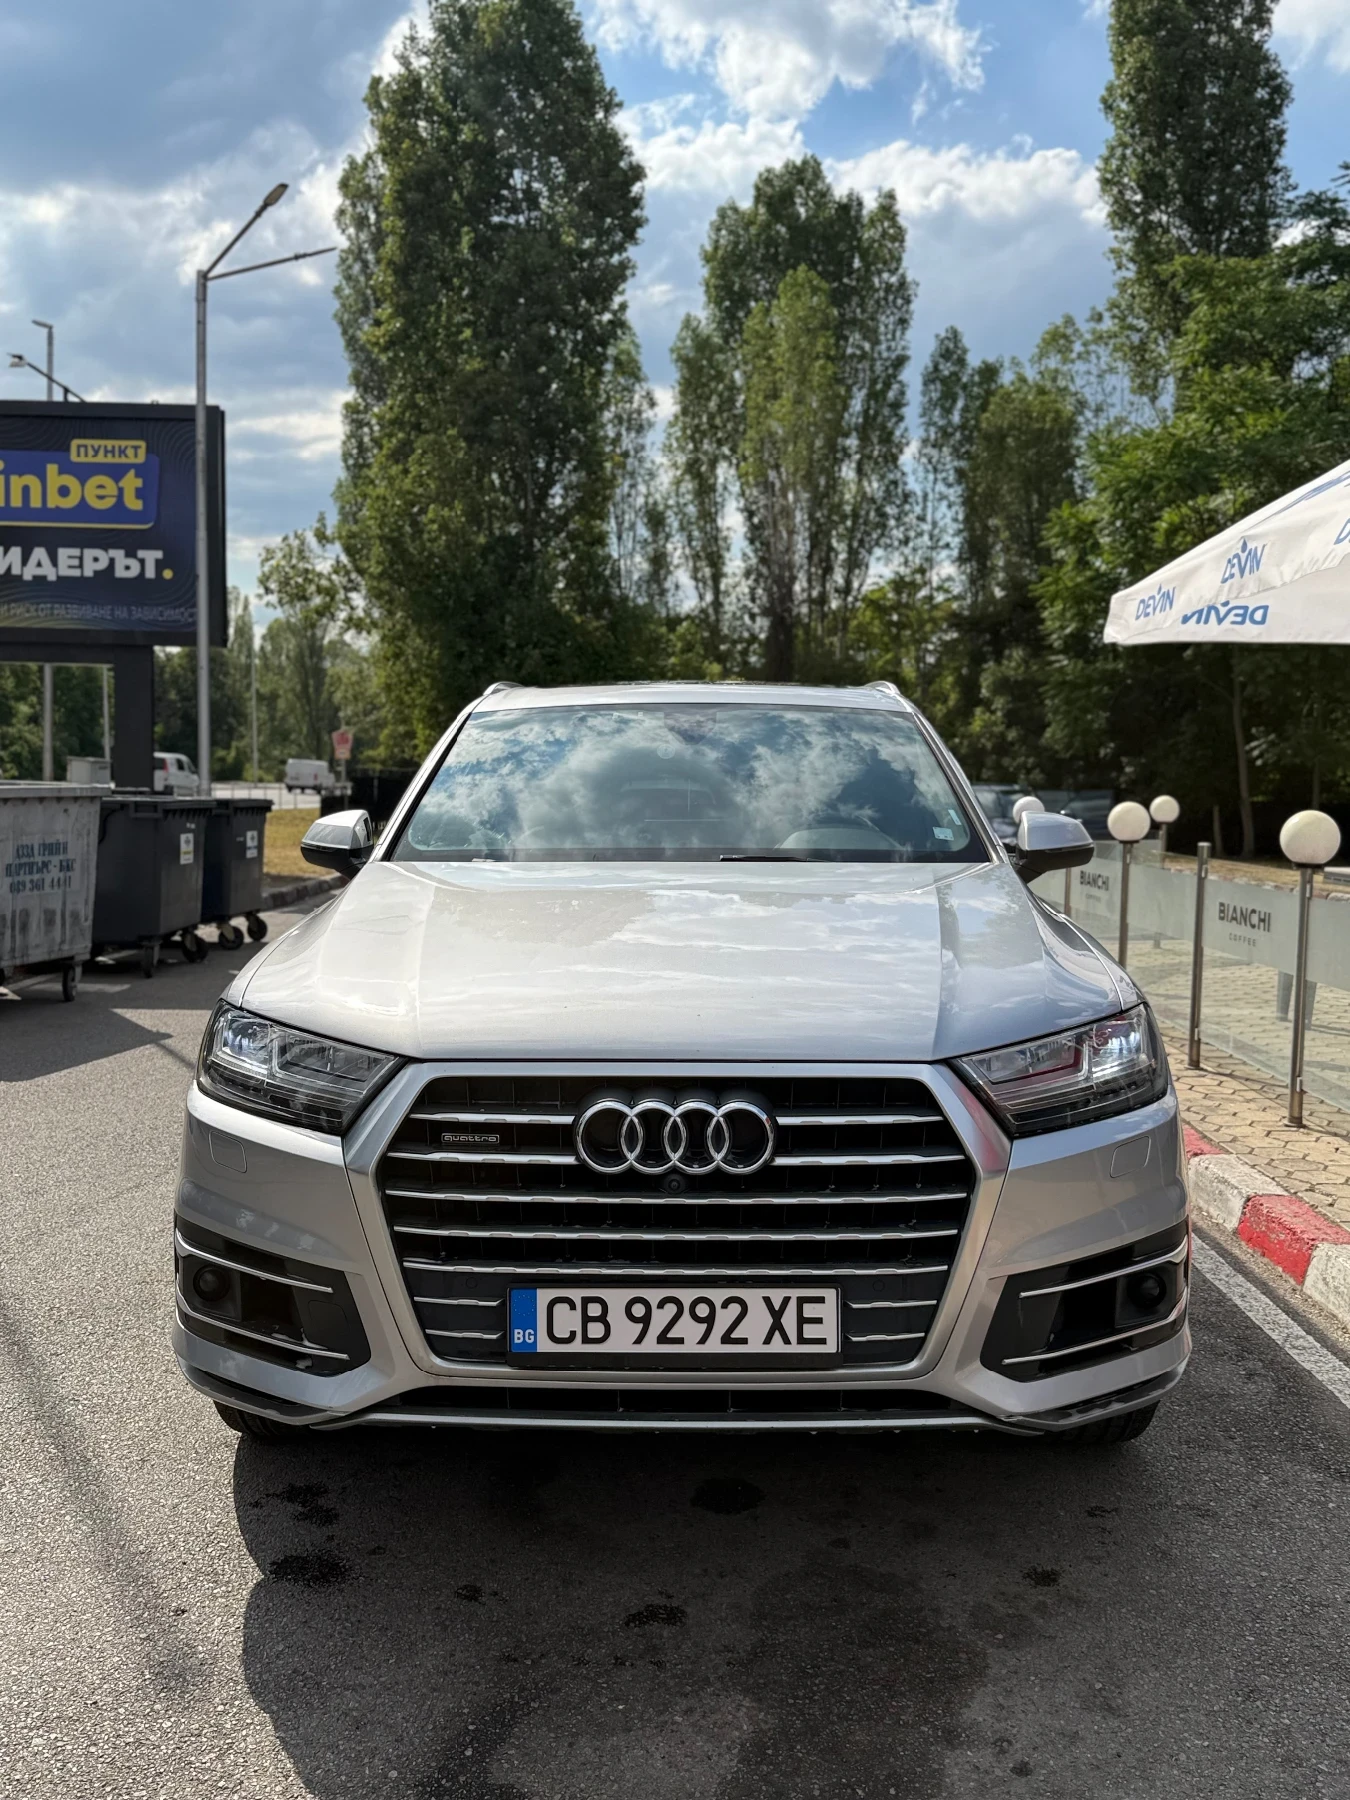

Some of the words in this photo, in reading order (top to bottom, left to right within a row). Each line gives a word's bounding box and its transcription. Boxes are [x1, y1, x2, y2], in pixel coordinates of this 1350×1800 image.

[76, 444, 142, 458] ПУНКТ
[0, 546, 174, 581] ИДЕРЪТ.
[1220, 539, 1267, 584] DEVIN
[38, 603, 52, 618] ОТ
[54, 604, 112, 620] РАЗВИВАНЕ
[115, 605, 129, 620] НА
[1135, 585, 1176, 621] DEVIN
[1080, 870, 1109, 891] BIANCHI
[1218, 902, 1271, 932] BIANCHI
[1229, 932, 1257, 947] COFFEE
[546, 1296, 611, 1345] CB
[624, 1296, 749, 1345] 9292
[762, 1296, 827, 1345] XE
[514, 1329, 535, 1343] BG
